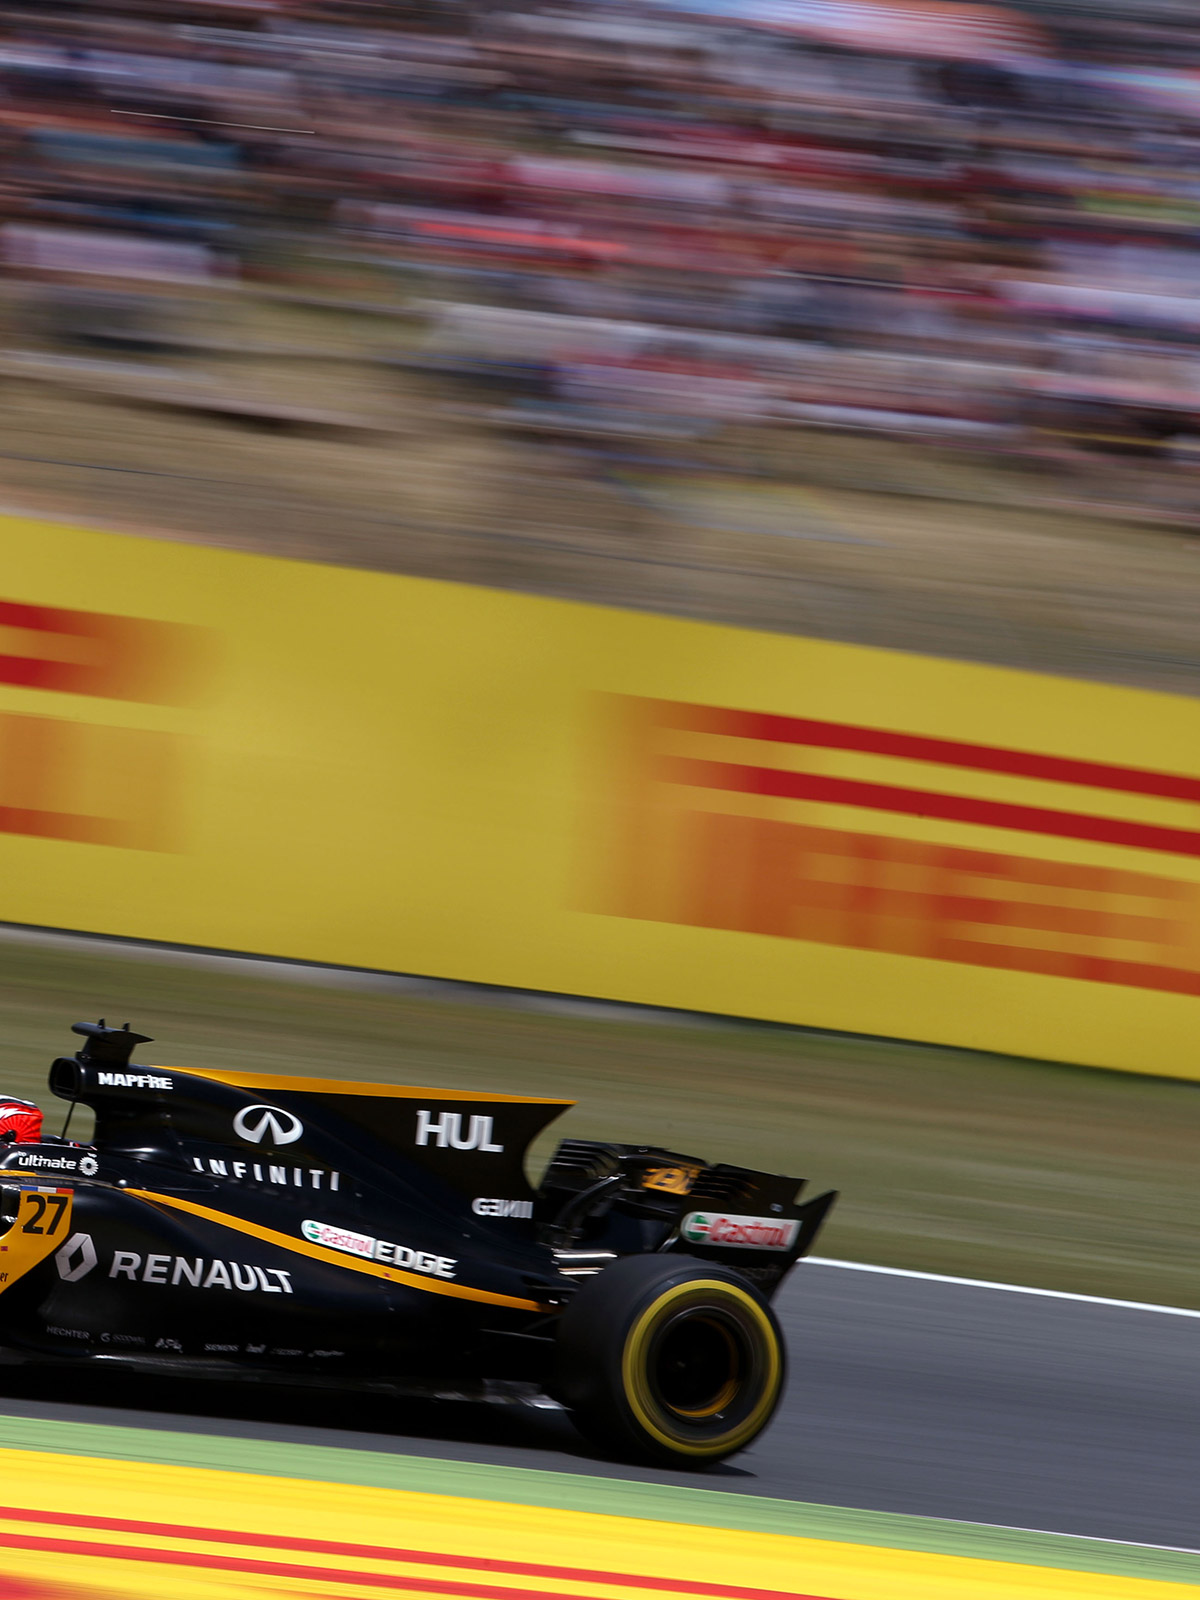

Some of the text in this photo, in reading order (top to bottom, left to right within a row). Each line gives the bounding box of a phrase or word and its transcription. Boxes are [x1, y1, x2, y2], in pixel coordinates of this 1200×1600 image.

[98, 1072, 174, 1090] MAPFRE
[415, 1110, 504, 1152] HUL
[18, 1154, 77, 1170] ultimate
[193, 1157, 340, 1191] INFINITI
[23, 1195, 68, 1235] 27
[710, 1218, 793, 1247] Castrol
[108, 1250, 293, 1293] RENAULT
[320, 1227, 458, 1279] Castrol EDGE
